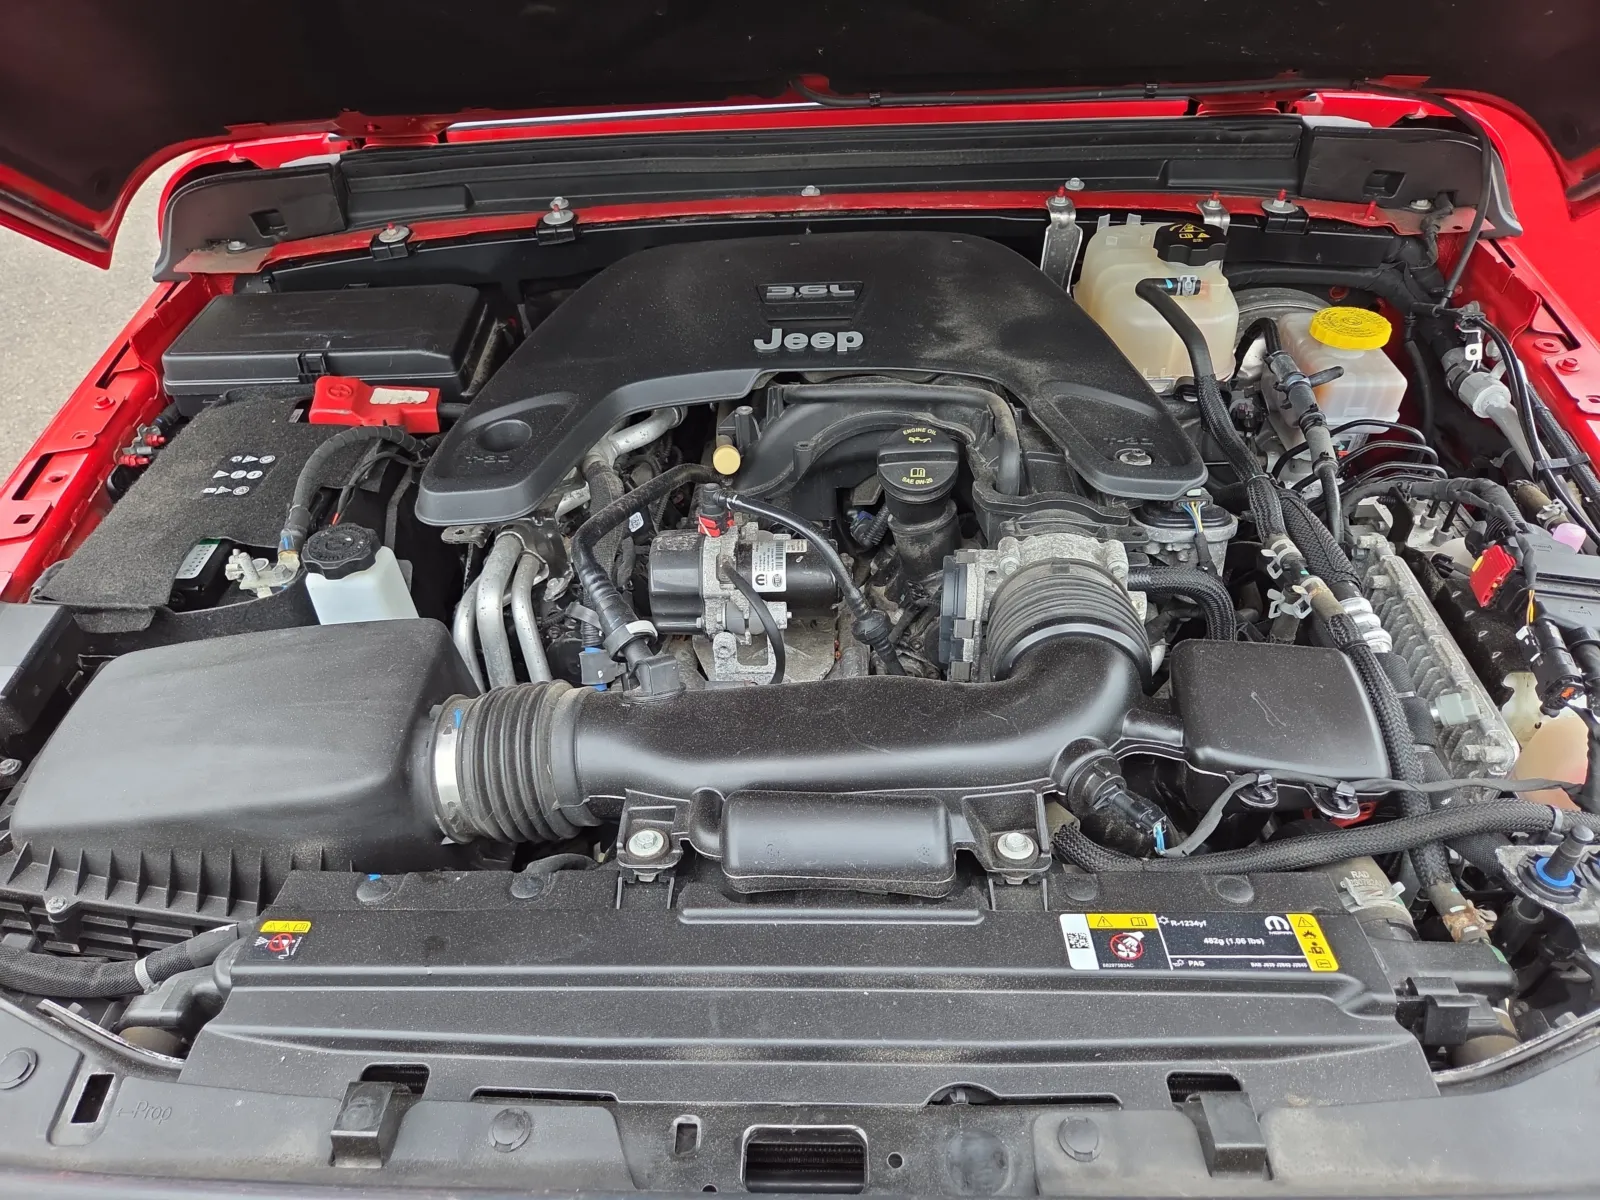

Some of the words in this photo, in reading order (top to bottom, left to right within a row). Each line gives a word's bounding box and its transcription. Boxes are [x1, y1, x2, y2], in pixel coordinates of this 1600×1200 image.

[766, 284, 855, 299] 3.6L
[753, 328, 864, 353] Jeep
[902, 427, 927, 436] ENGINE
[927, 428, 937, 436] OIL
[901, 476, 914, 485] SAE
[1350, 870, 1370, 879] RAD
[133, 1099, 173, 1125] Prop
